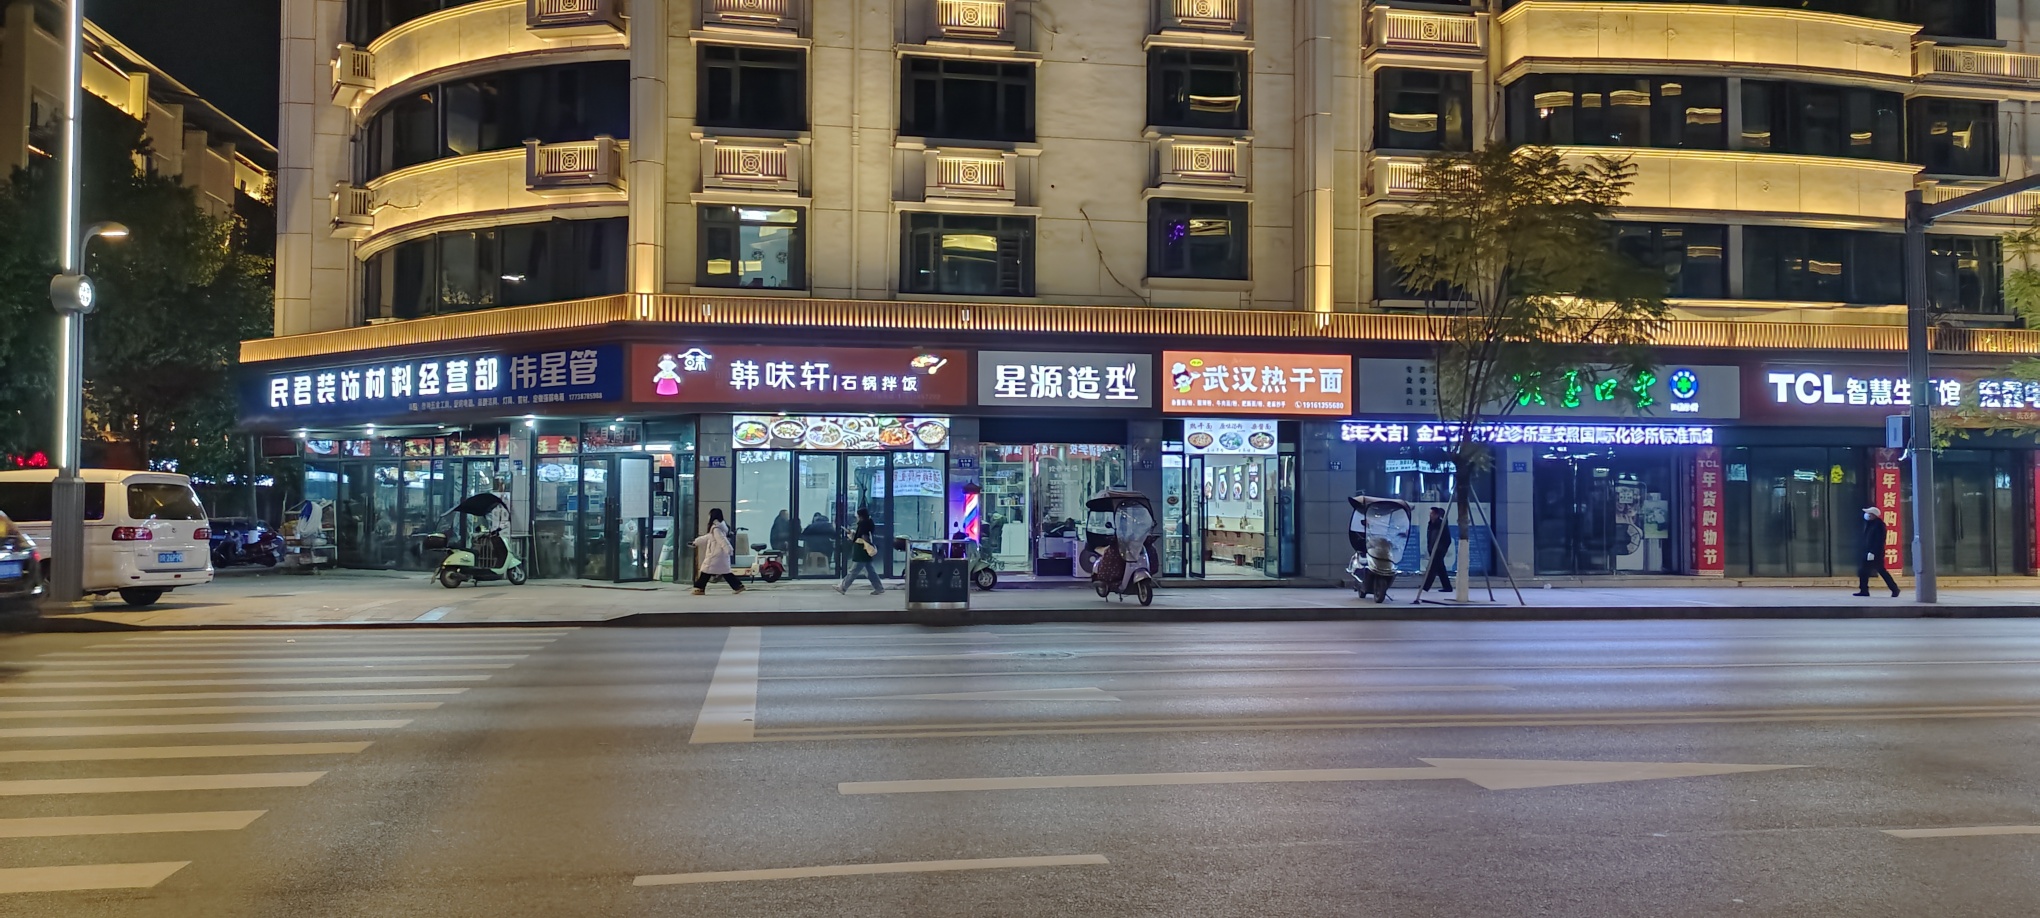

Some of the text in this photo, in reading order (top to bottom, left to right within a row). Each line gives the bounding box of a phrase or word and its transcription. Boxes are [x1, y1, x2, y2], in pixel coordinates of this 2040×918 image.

[271, 350, 598, 408] 民君装饰材料经营部 伟星管
[729, 360, 918, 392] 韩味轩 石锅拌饭
[994, 362, 1139, 400] 星源造型
[1202, 365, 1344, 394] 武汉热干面
[1698, 460, 1719, 468] TCL
[1702, 472, 1717, 565] 年货购物节
